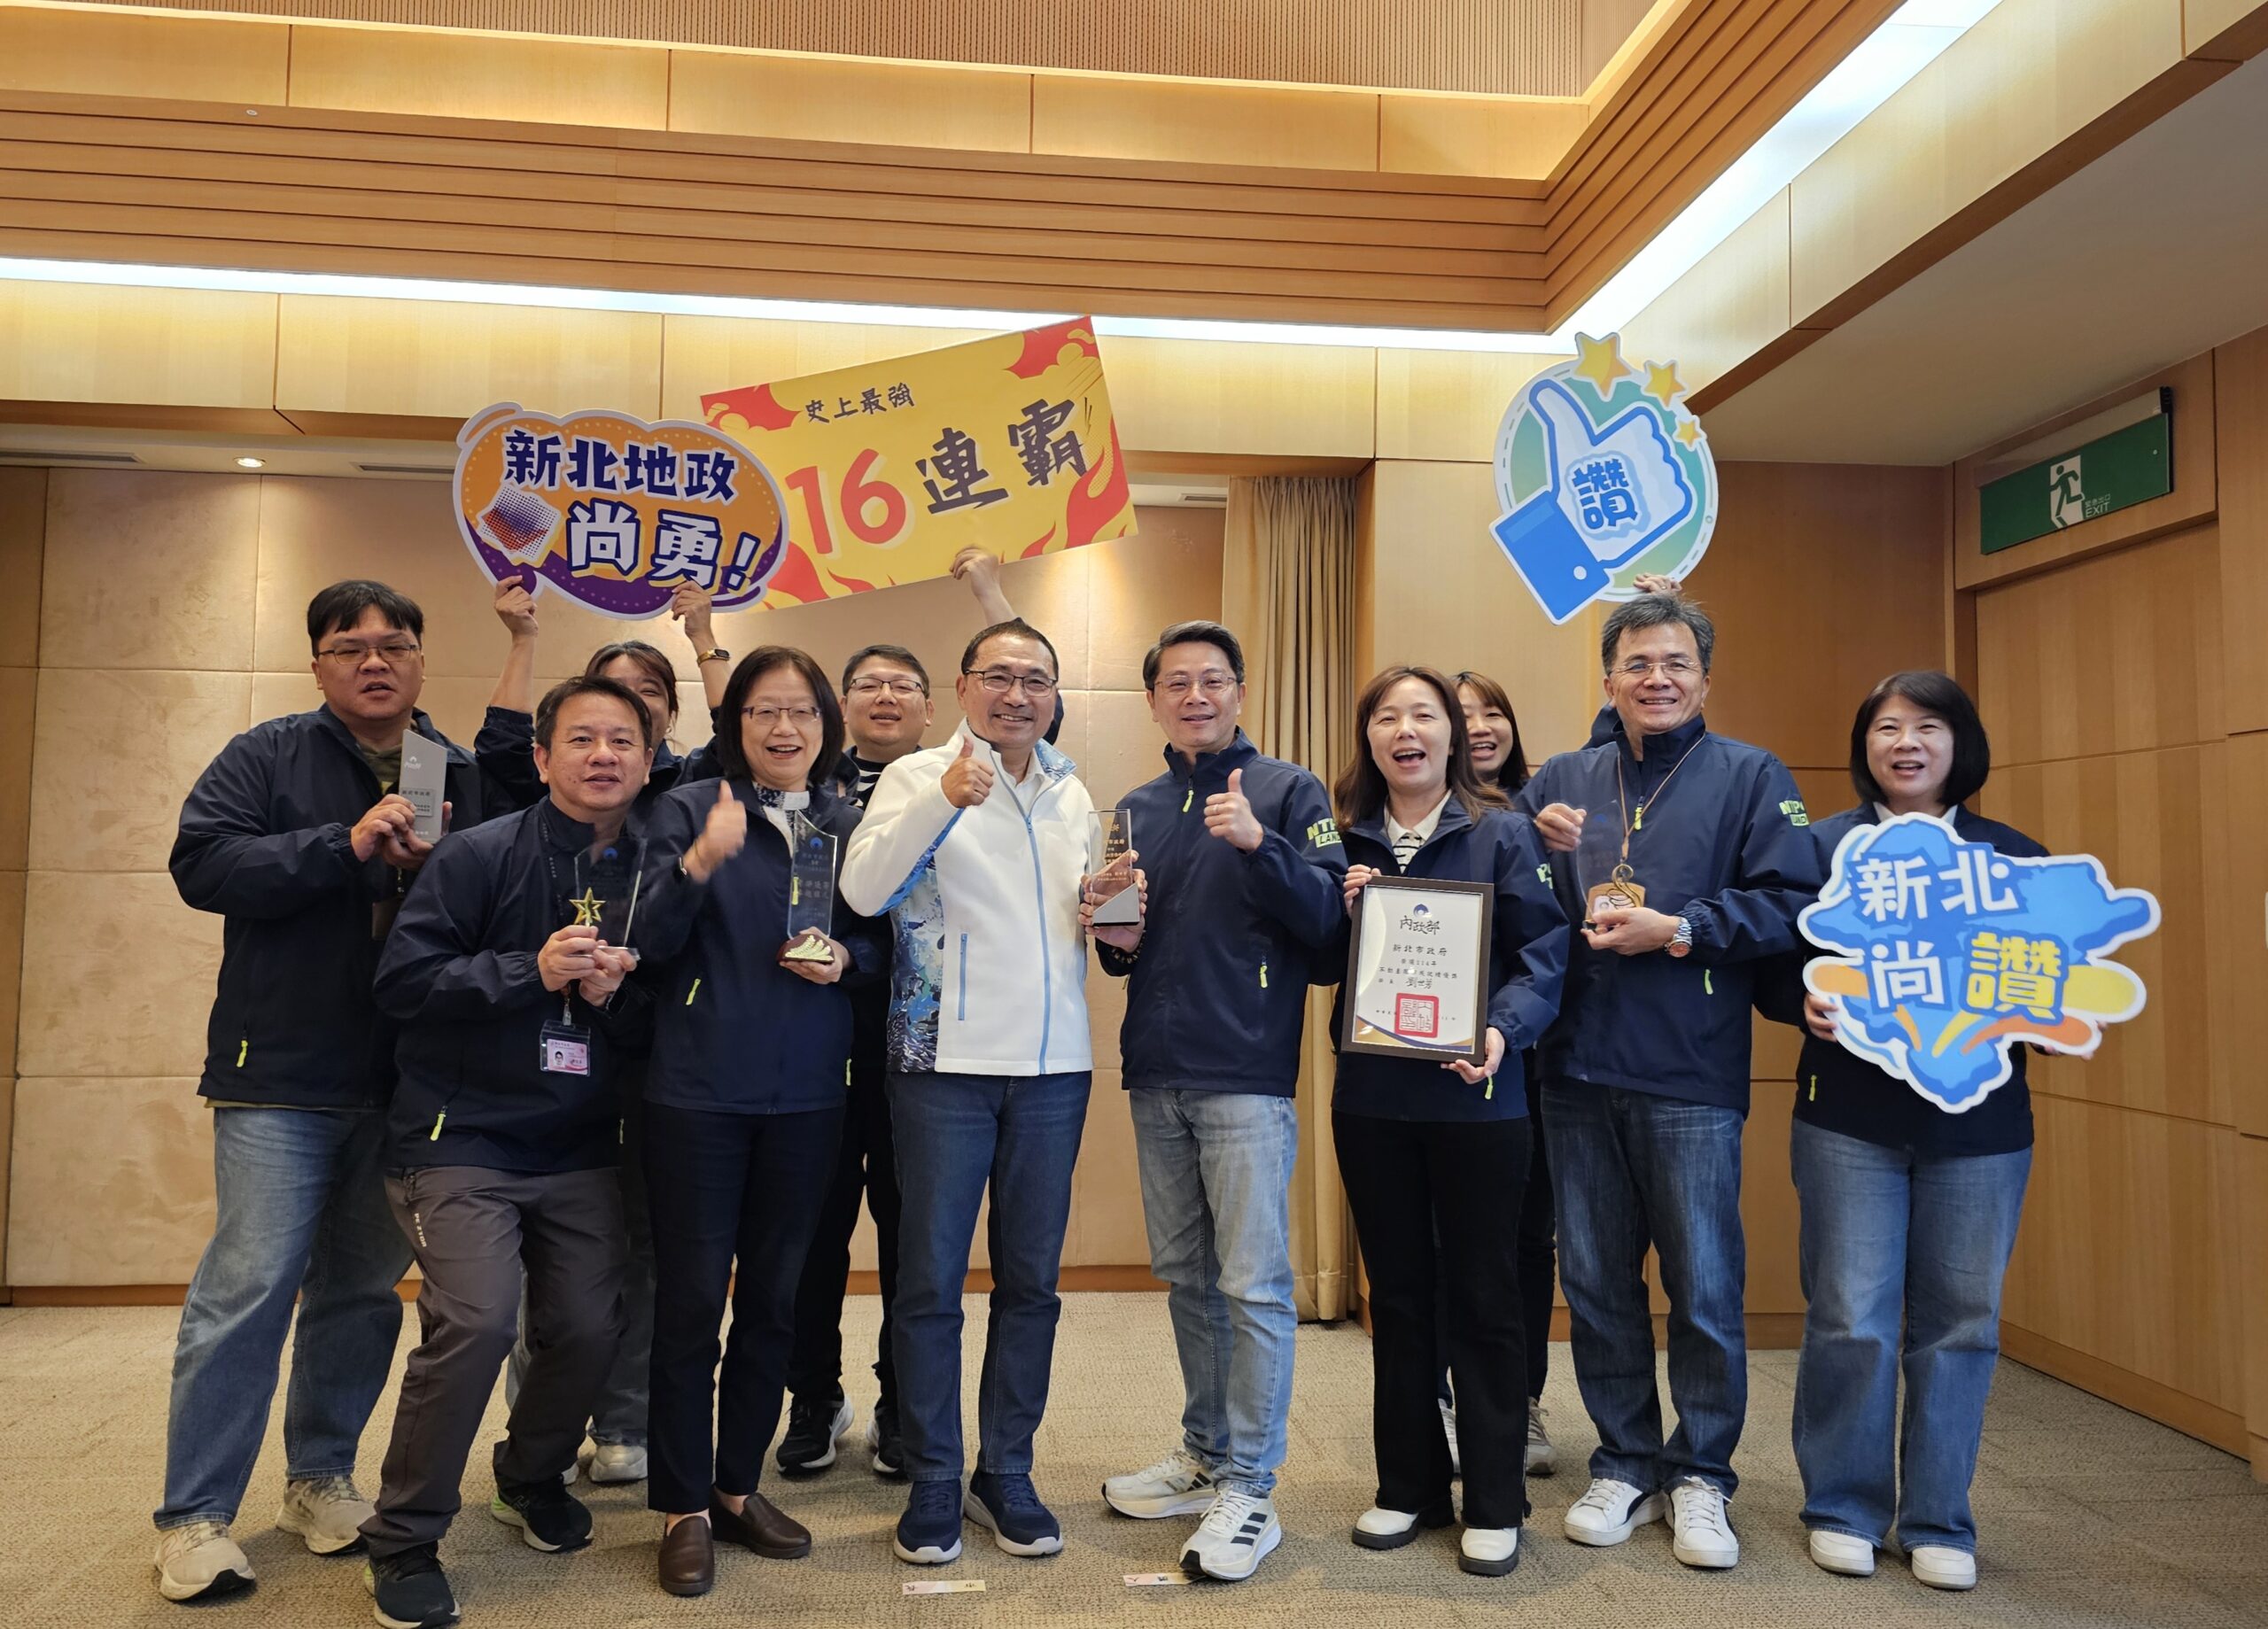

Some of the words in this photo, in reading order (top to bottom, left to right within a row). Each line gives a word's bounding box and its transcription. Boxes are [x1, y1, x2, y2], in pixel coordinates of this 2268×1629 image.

[805, 383, 914, 423] 史上最強
[504, 430, 735, 501] 新北地政
[1572, 458, 1638, 530] 讚
[2085, 501, 2110, 518] EXIT
[1856, 849, 2019, 922] 新北
[1870, 932, 2062, 1020] 尚讚
